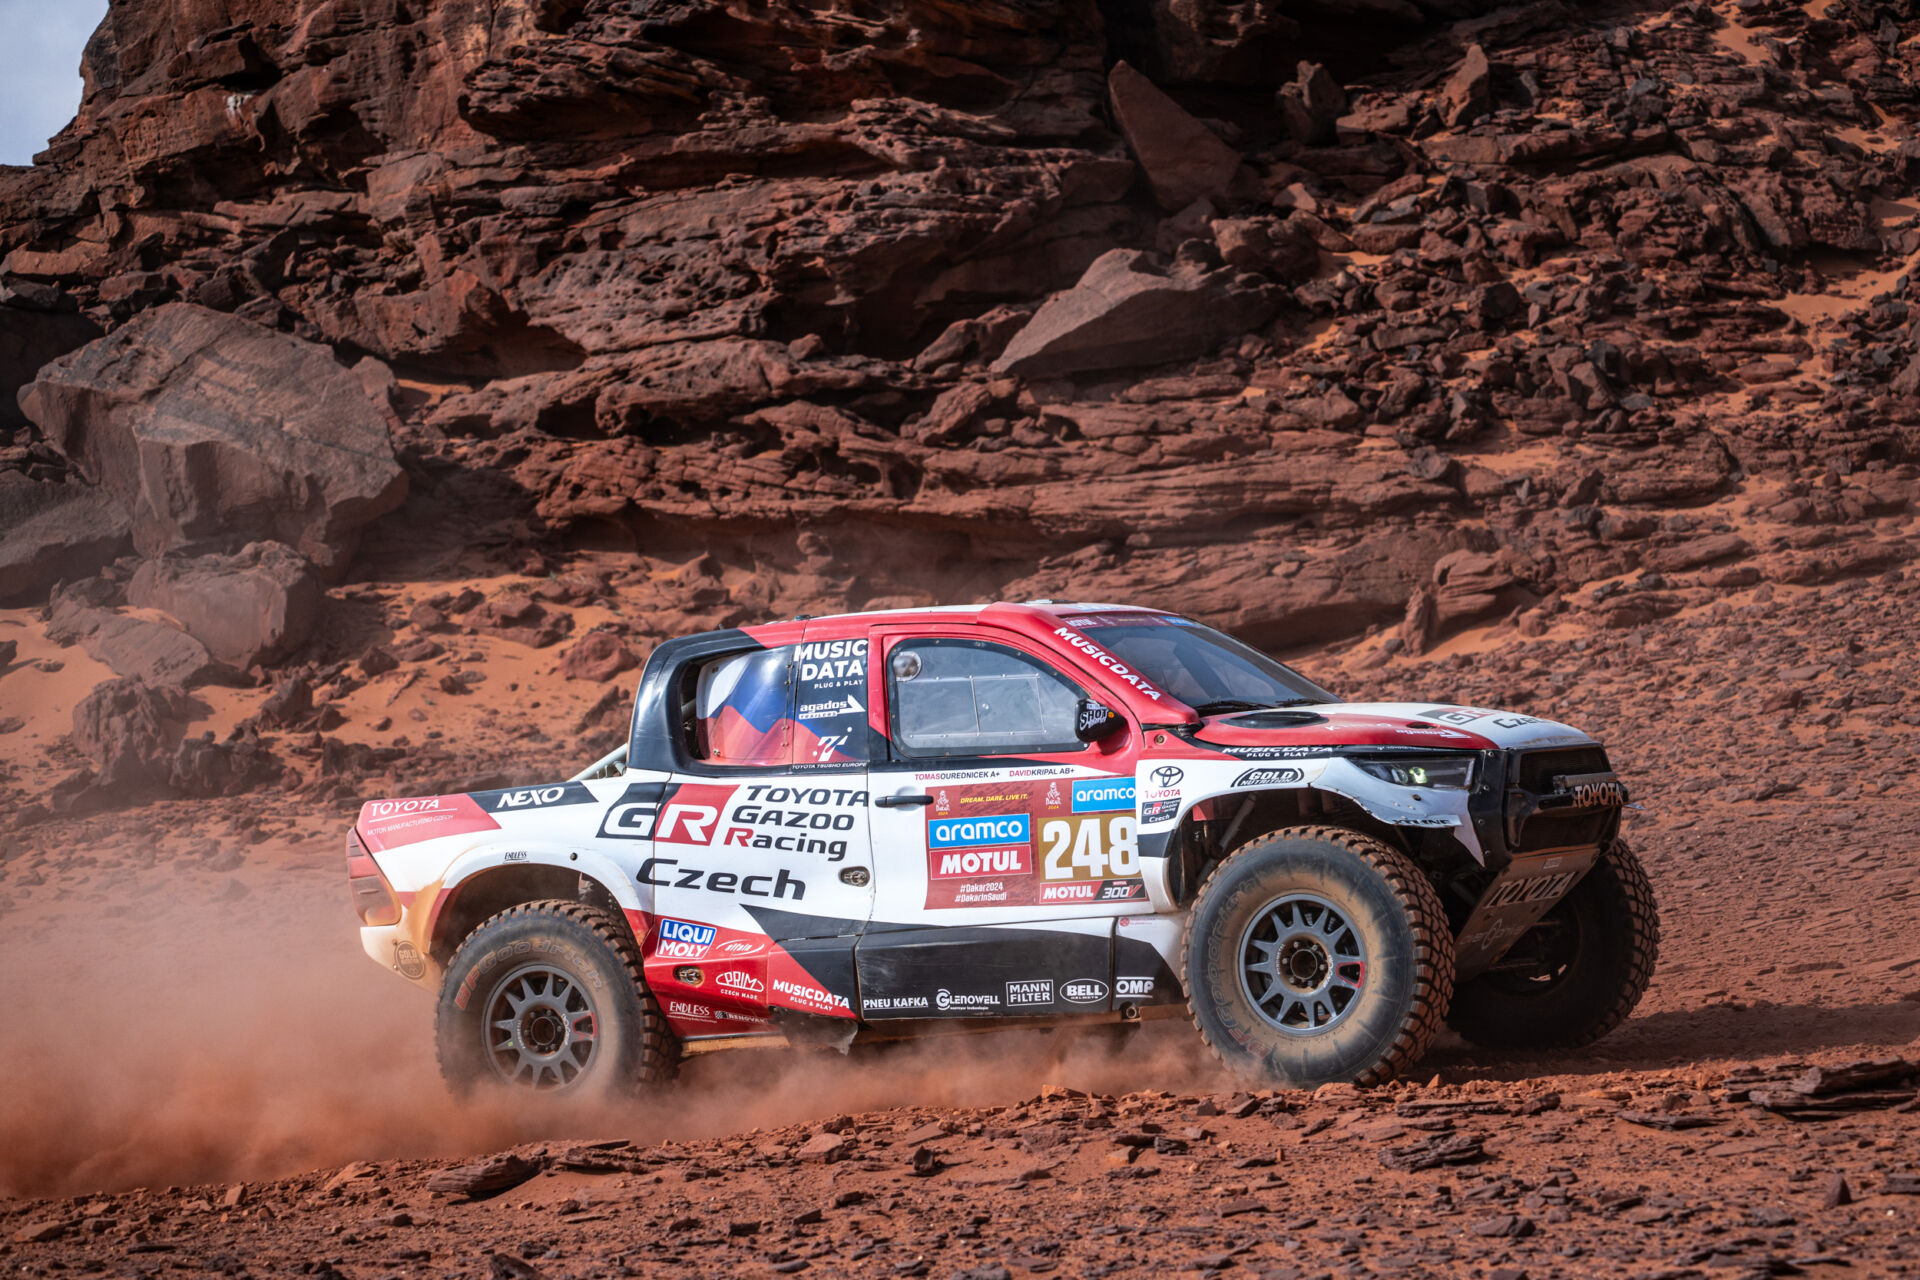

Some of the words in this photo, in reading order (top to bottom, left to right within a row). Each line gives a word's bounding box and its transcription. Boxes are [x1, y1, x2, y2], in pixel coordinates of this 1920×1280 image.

[793, 639, 868, 662] MUSIC
[801, 659, 864, 681] DATA
[1054, 627, 1161, 700] MUSICDATA
[800, 701, 847, 713] agados
[1222, 746, 1334, 755] MUSICDATA
[1248, 772, 1294, 780] GOLD
[496, 787, 565, 809] NEXO
[747, 785, 869, 807] TOYOTA
[1076, 787, 1137, 802] aramco
[1144, 789, 1181, 799] TOYOTA
[1575, 782, 1624, 809] TOYOTA
[371, 799, 440, 817] TOYOTA
[1144, 806, 1162, 815] GR
[604, 802, 718, 842] GR
[732, 805, 855, 831] GAZOO
[936, 820, 1023, 842] aramco
[723, 827, 848, 862] Racing
[1043, 816, 1141, 880] 248
[504, 851, 528, 861] ENDLESS
[940, 850, 1023, 875] MOTUL
[636, 857, 806, 901] Czech
[960, 881, 1004, 894] #Dakar2024
[1043, 884, 1094, 900] MOTUL
[1102, 884, 1143, 900] 300V
[1484, 872, 1578, 908] TOYOTA
[662, 921, 715, 945] LIQUI
[659, 942, 707, 958] MOLY
[724, 970, 759, 990] PRIM
[1009, 982, 1050, 993] MANN
[1116, 980, 1154, 994] OMP
[720, 988, 740, 997] CZECH
[773, 979, 850, 1009] MUSICDATA
[1009, 992, 1051, 1003] FILTER
[1066, 984, 1103, 996] BELL
[670, 1001, 710, 1016] ENDLESS
[790, 996, 807, 1005] PLUG
[815, 1003, 832, 1012] PLAY
[863, 998, 891, 1009] PNEU
[893, 997, 929, 1008] KAFKA
